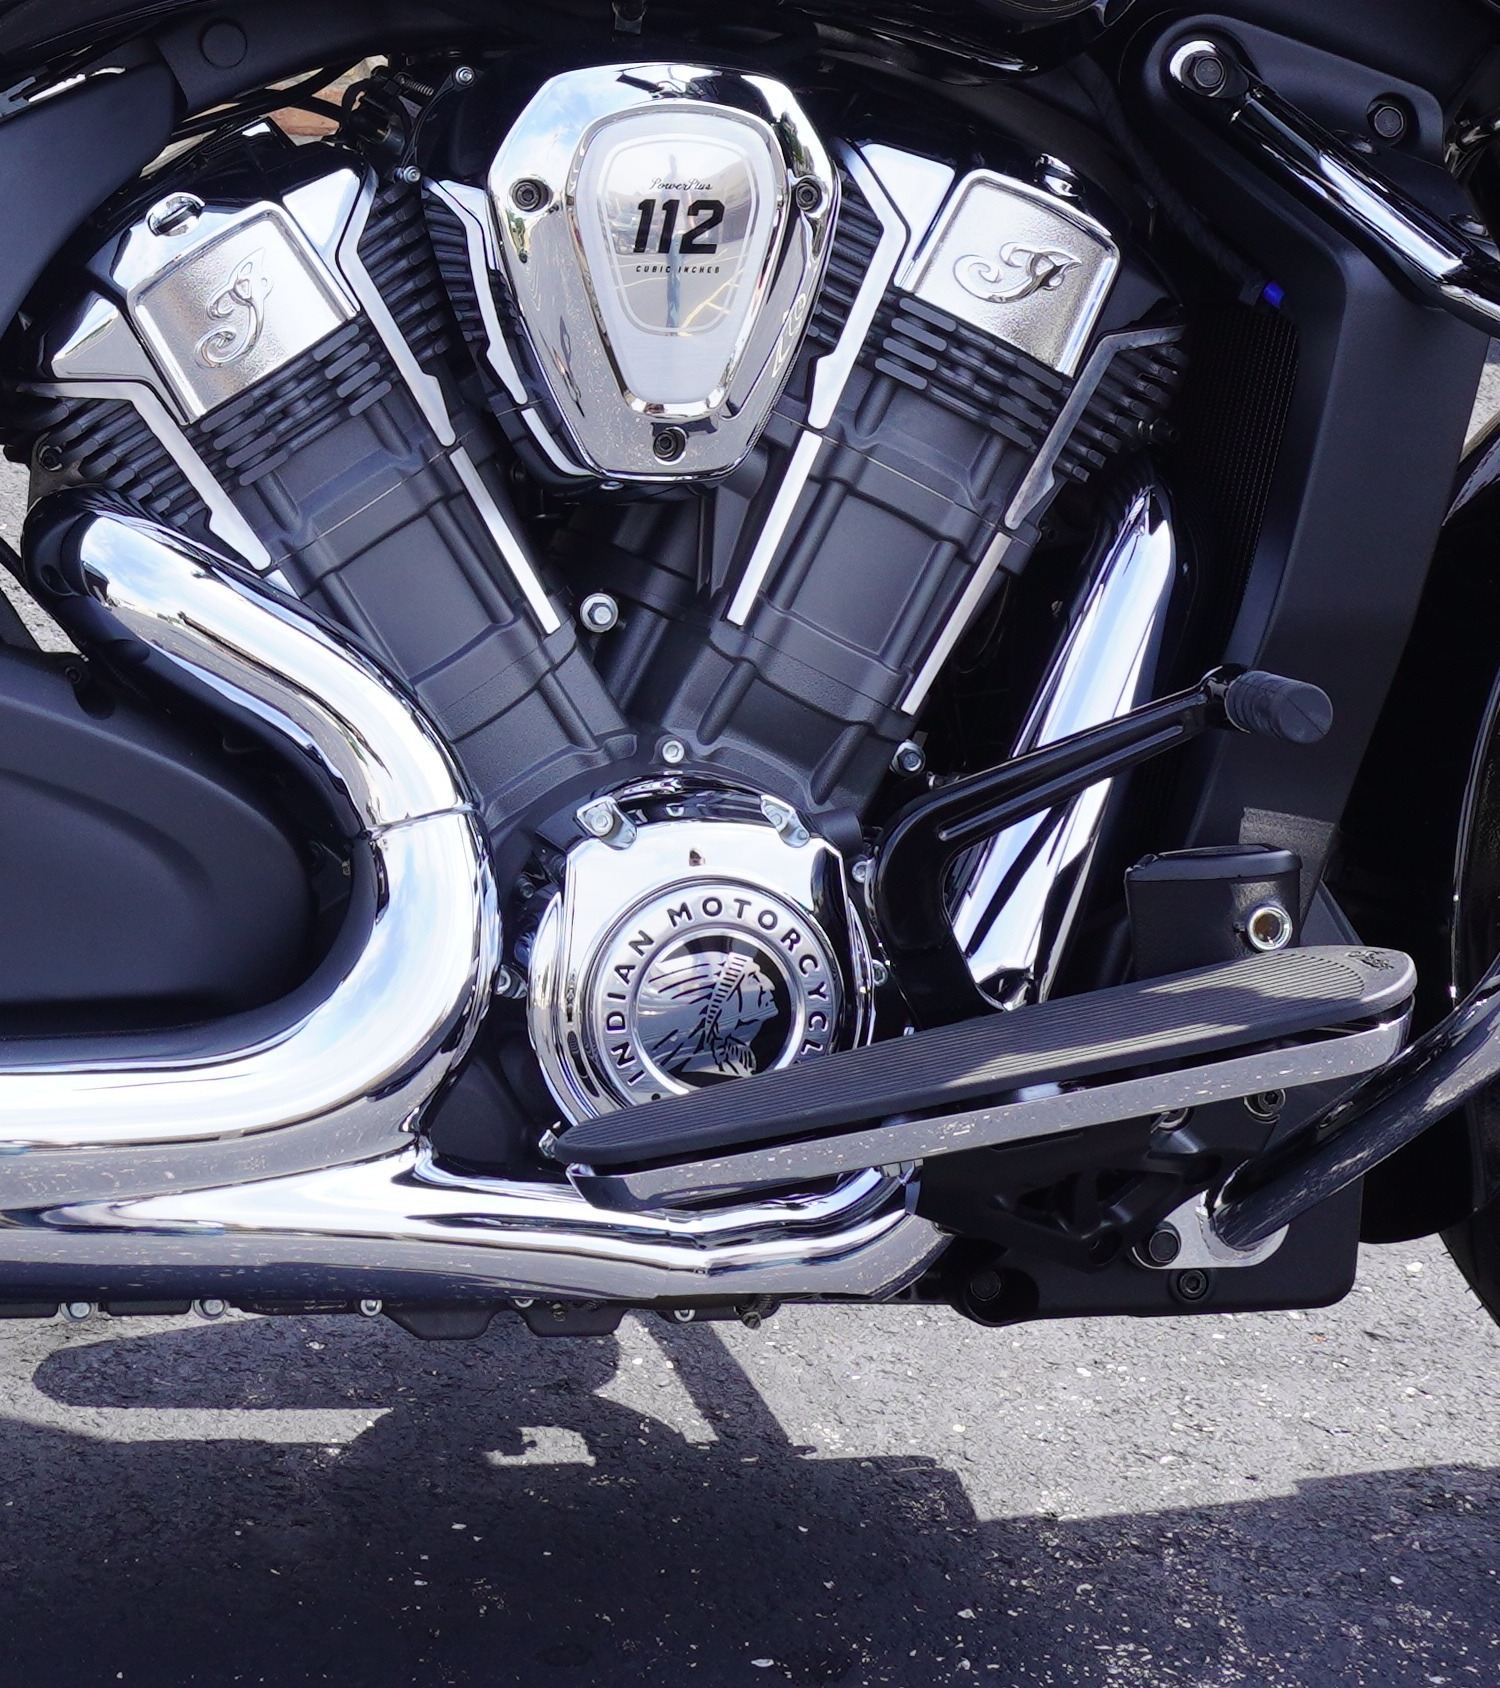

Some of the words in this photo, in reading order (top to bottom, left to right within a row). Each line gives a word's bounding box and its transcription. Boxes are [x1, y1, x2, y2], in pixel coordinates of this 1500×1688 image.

[632, 198, 726, 255] 112
[635, 264, 672, 274] CUBIC
[677, 264, 721, 275] INCHES
[606, 928, 656, 1088] INDIAN
[666, 896, 830, 1057] MOTORCYCL
